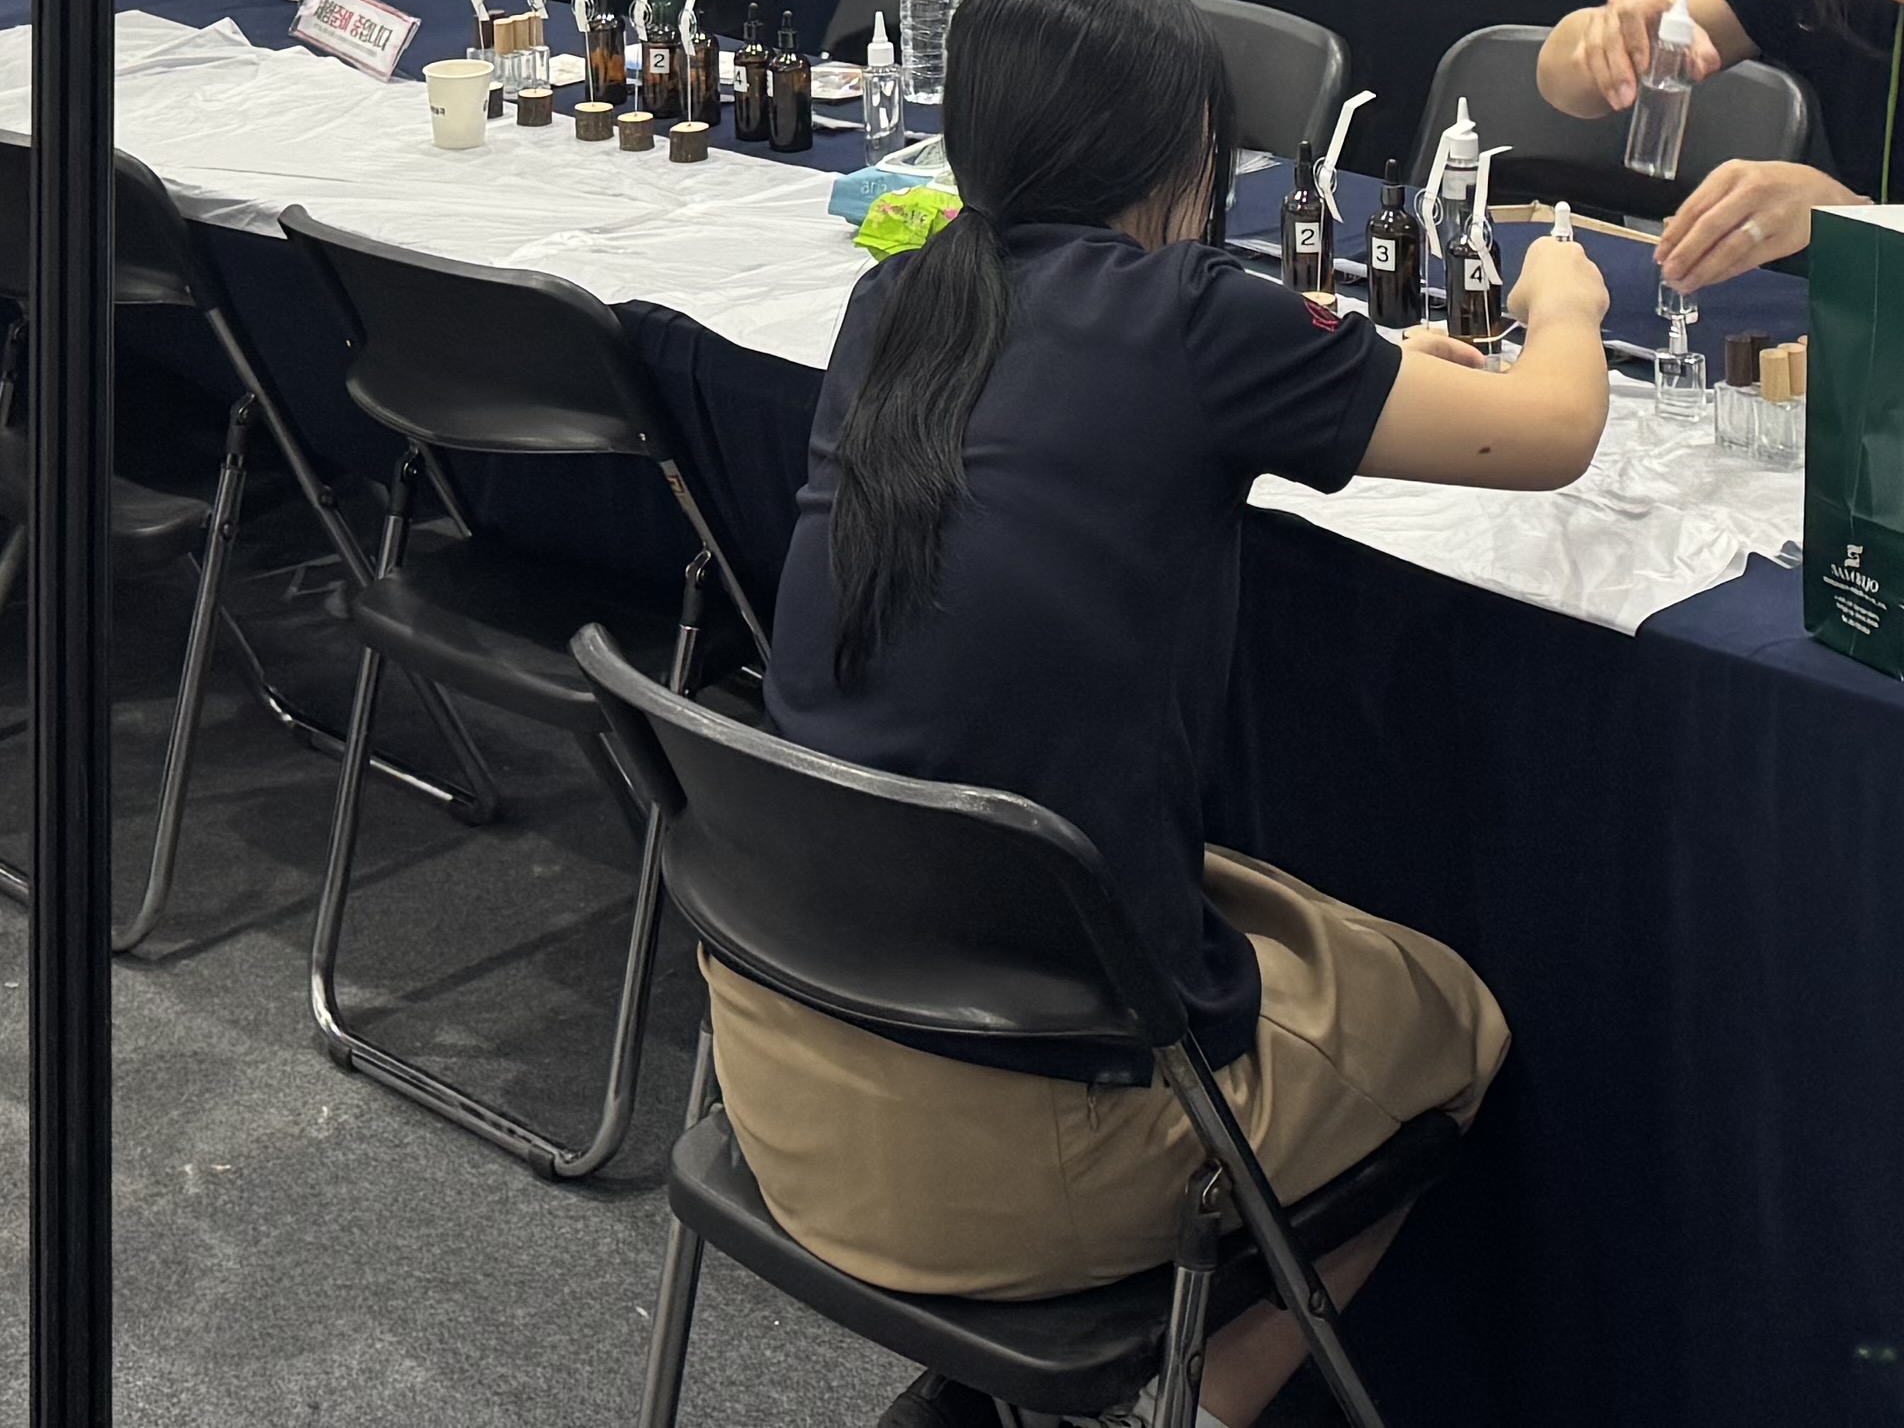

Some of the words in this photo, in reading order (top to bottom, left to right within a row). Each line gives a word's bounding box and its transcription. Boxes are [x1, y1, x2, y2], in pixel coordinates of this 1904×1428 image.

[654, 54, 666, 68] 2
[1300, 229, 1315, 246] 2
[1376, 245, 1389, 263] 3
[1470, 265, 1483, 284] 4
